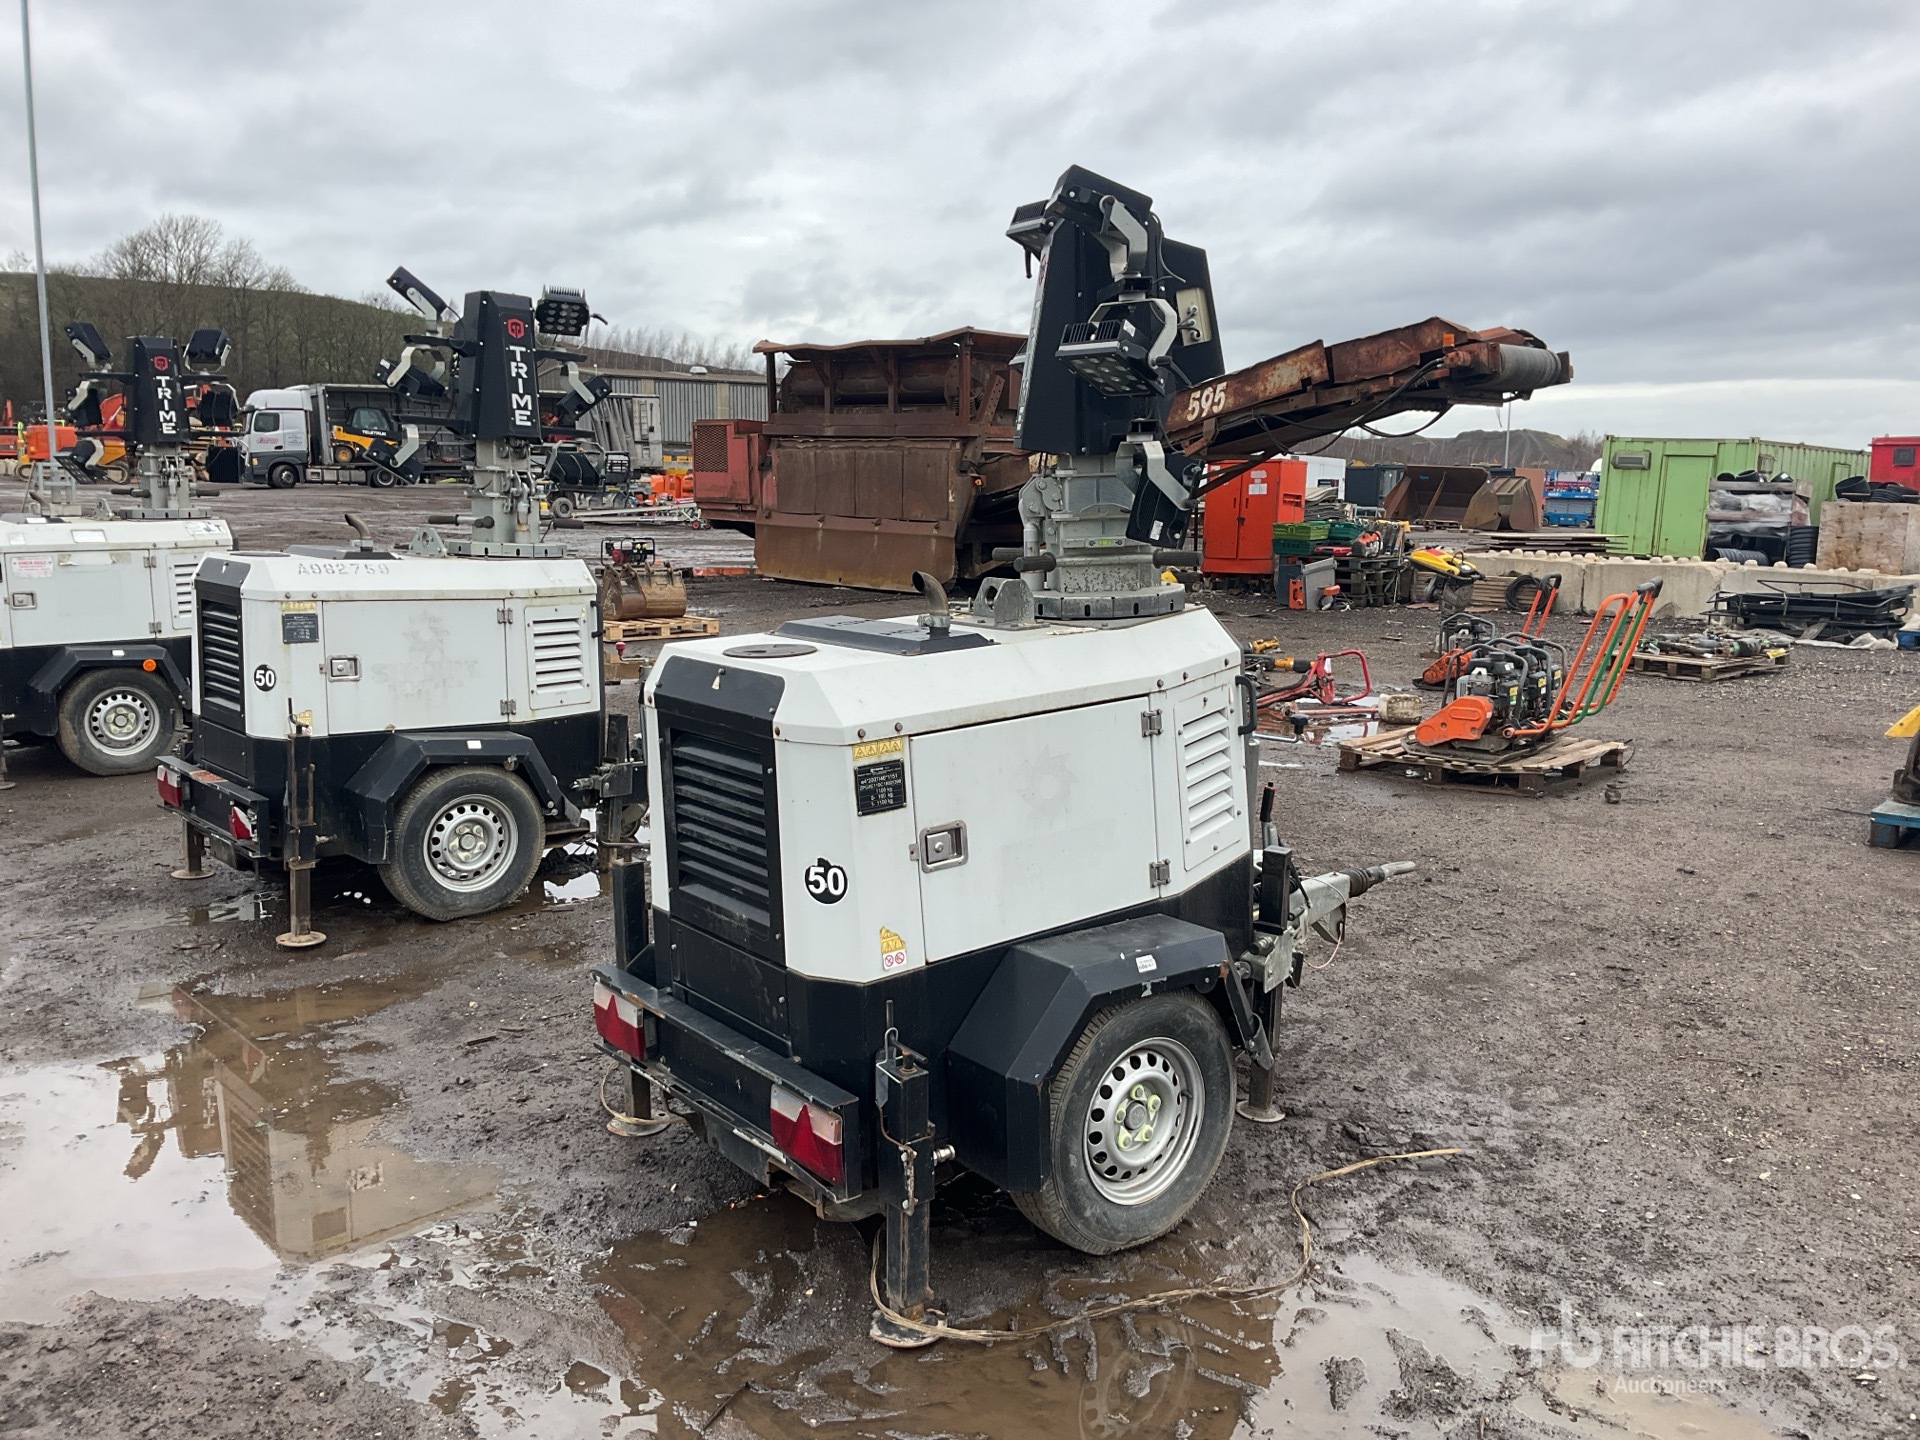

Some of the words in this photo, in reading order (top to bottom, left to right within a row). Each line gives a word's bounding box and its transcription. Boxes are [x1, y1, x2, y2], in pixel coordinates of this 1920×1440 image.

[155, 375, 177, 434] TRIME
[508, 345, 533, 427] TRIME
[1186, 381, 1227, 421] 595
[255, 670, 275, 687] 50
[808, 866, 845, 896] 50
